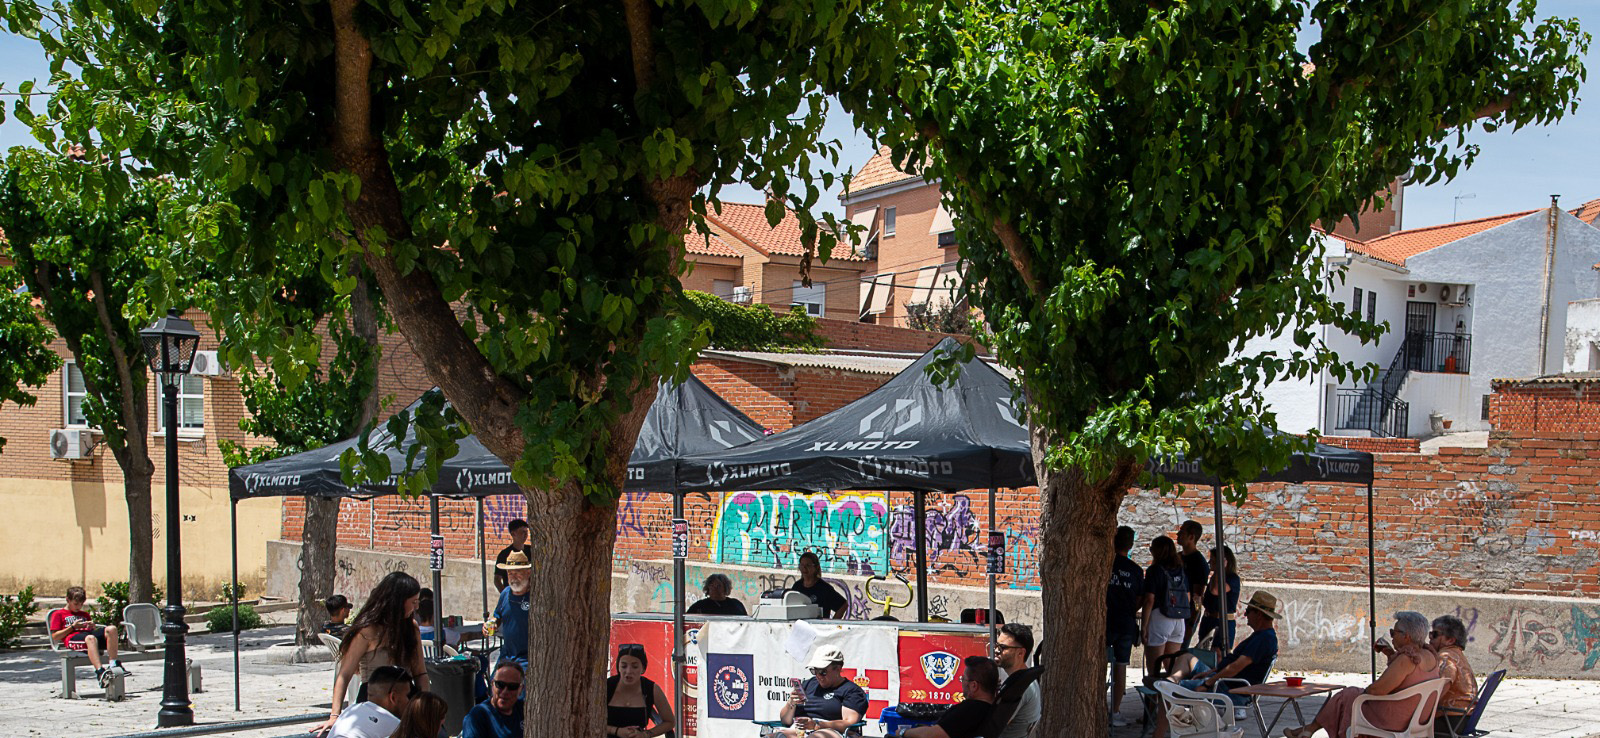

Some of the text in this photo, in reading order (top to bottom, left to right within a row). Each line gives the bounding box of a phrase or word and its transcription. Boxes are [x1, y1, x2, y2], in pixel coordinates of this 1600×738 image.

[804, 440, 920, 452] XLMOTO
[729, 462, 792, 479] XLMOTO
[884, 461, 953, 475] XLMOTO
[1329, 462, 1360, 474] XLMOTO
[257, 474, 301, 487] XLMOTO
[474, 472, 518, 486] XLMOT
[746, 505, 865, 542] MARIANO
[758, 675, 772, 687] Por
[774, 675, 786, 687] Una
[767, 690, 780, 701] Con
[928, 691, 951, 700] 1870
